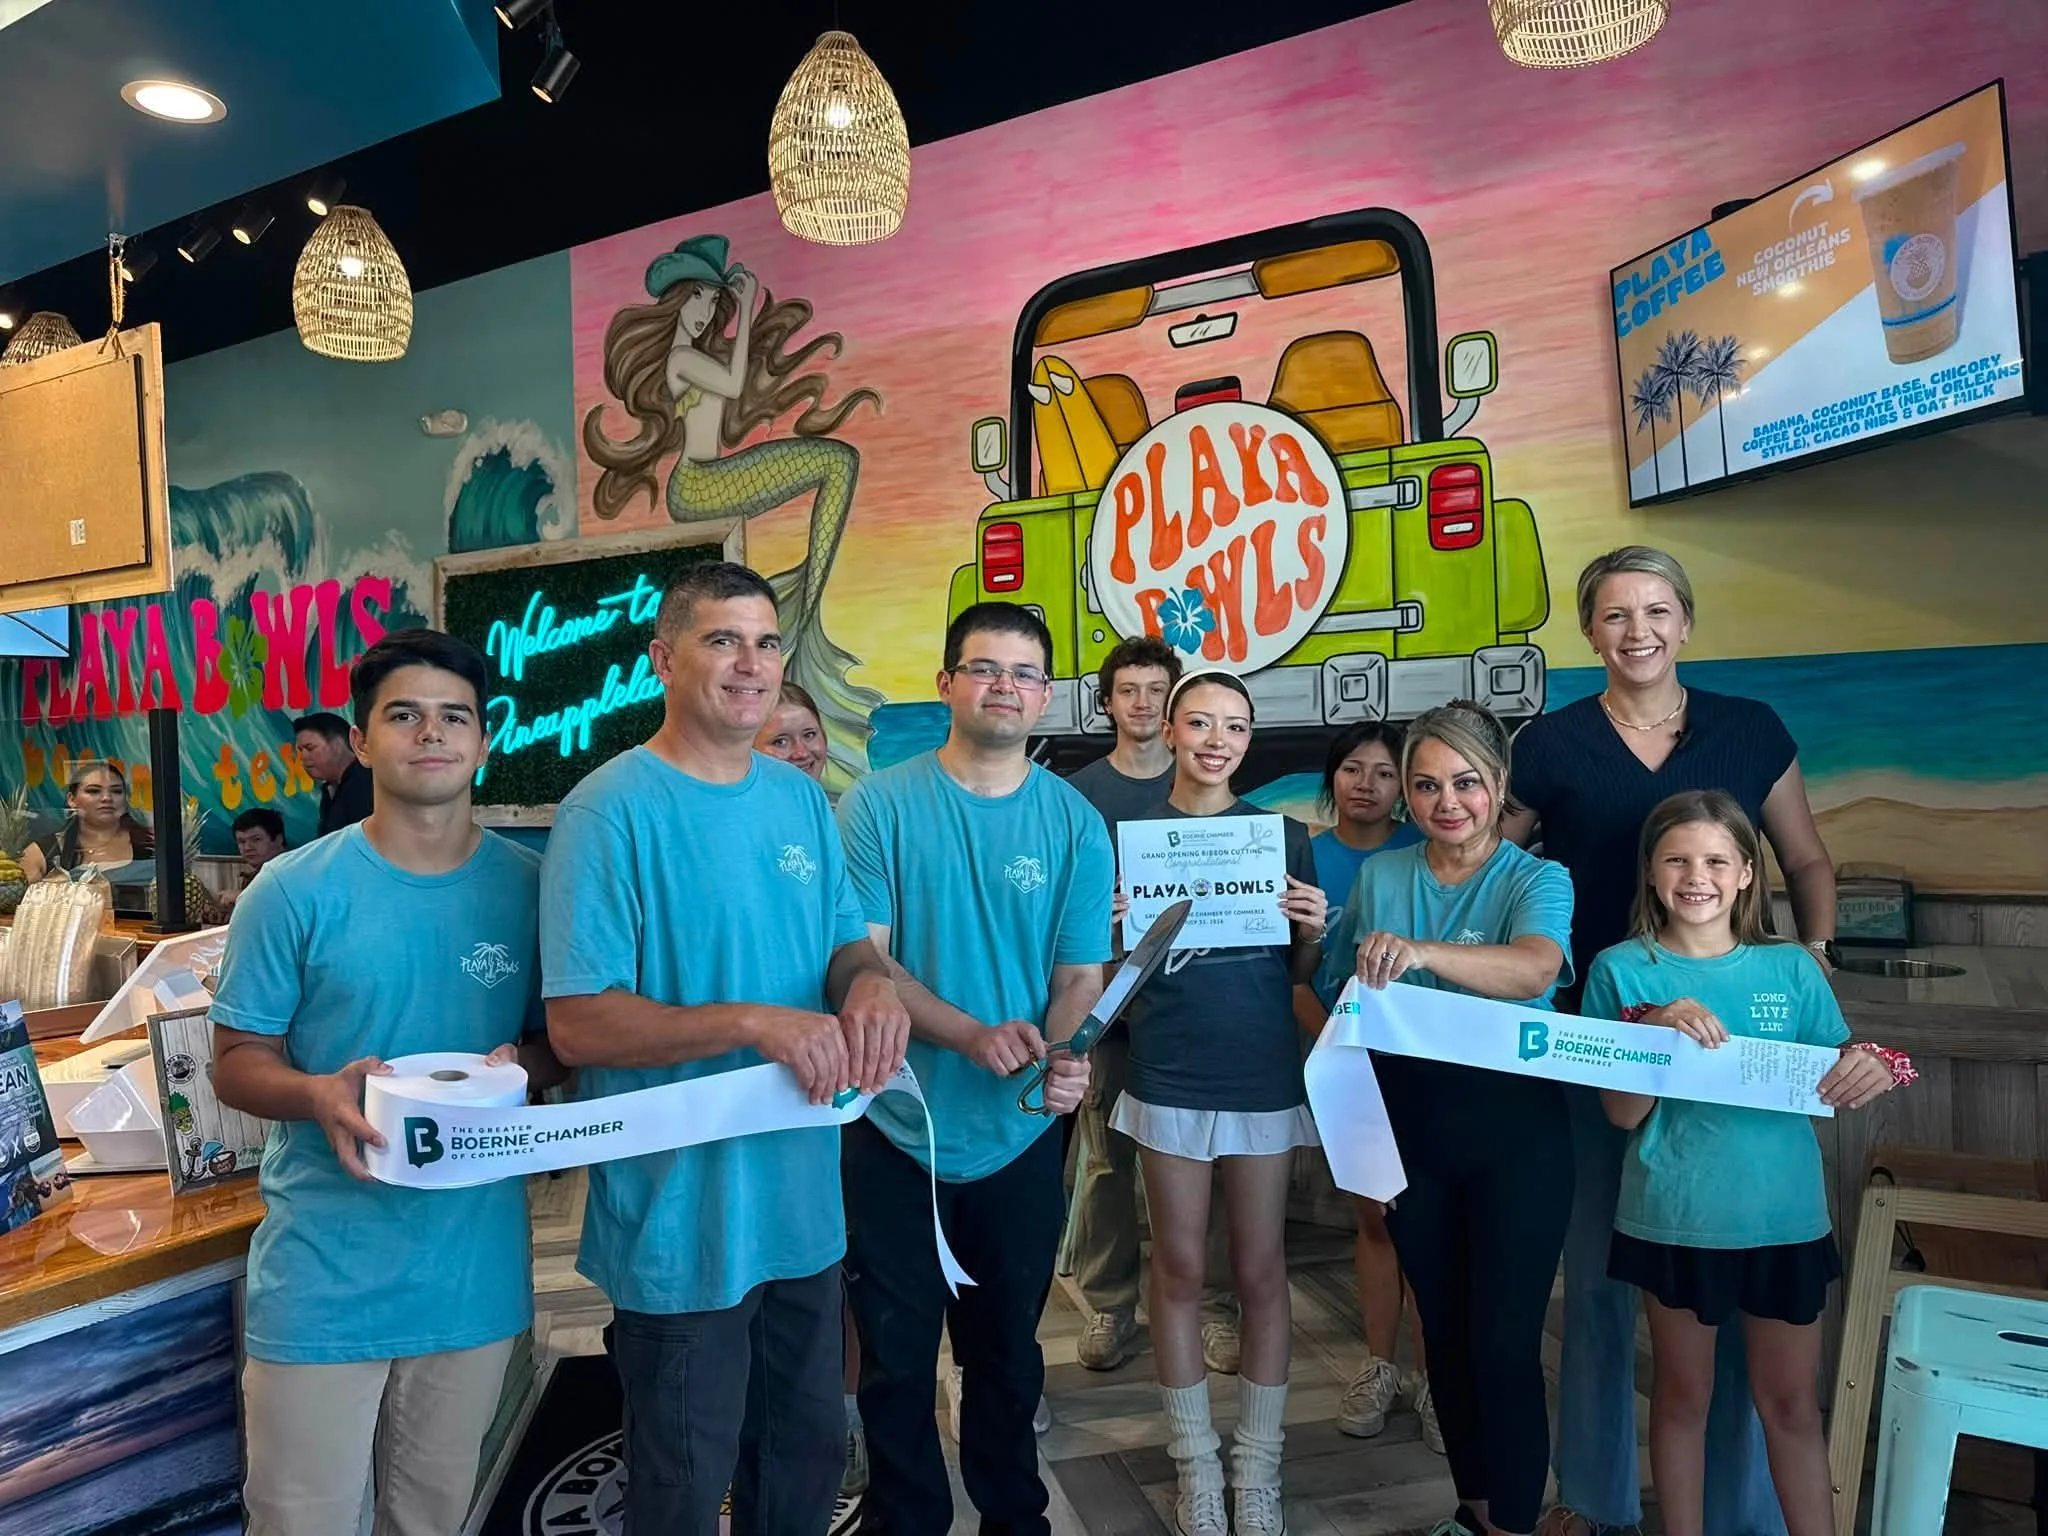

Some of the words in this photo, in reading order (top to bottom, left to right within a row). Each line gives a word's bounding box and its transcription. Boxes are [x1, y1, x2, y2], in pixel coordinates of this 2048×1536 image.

[1736, 263, 1769, 288] NEW
[1774, 228, 1851, 271] ORLEANS
[1754, 221, 1829, 265] COCONUT
[1615, 228, 1713, 309] PLAYA
[1752, 251, 1836, 296] SMOOTHIE
[1617, 249, 1726, 338] COFFEE
[1742, 431, 1790, 452] COFFEE
[1793, 400, 1895, 438] CONCENTRATE
[1898, 387, 1937, 409] (NEW
[1942, 363, 2021, 394] ORLEANS
[1753, 413, 1809, 438] BANANA,
[1812, 391, 1877, 420] COCONUT
[1881, 378, 1926, 400] BASE,
[1930, 353, 2003, 385] CHICORY
[1813, 422, 1860, 444] CACAO
[1864, 411, 1898, 431] NIBS
[1903, 408, 1912, 420] &
[1917, 397, 1948, 415] OAT
[1953, 384, 1995, 406] MILK
[1111, 421, 1329, 584] PLAYA
[486, 591, 624, 681] Welcome
[1141, 851, 1165, 860] GRAND
[1167, 850, 1199, 859] OPENING
[1201, 849, 1229, 857] RIBBON
[1230, 847, 1263, 856] CUTTING
[1133, 883, 1189, 898] PLAYA
[1215, 880, 1275, 896] BOWLS
[1750, 1006, 1789, 1019] LIVE
[1554, 1039, 1612, 1059] BOERNE
[1613, 1048, 1672, 1066] CHAMBER
[1577, 1032, 1615, 1044] GREATER
[1566, 1055, 1612, 1068] COMMERCE
[451, 1126, 473, 1134] THE
[478, 1124, 532, 1134] GREATER
[451, 1133, 529, 1150] BOERNE
[534, 1120, 624, 1144] CHAMBER
[471, 1147, 535, 1159] COMMERCE
